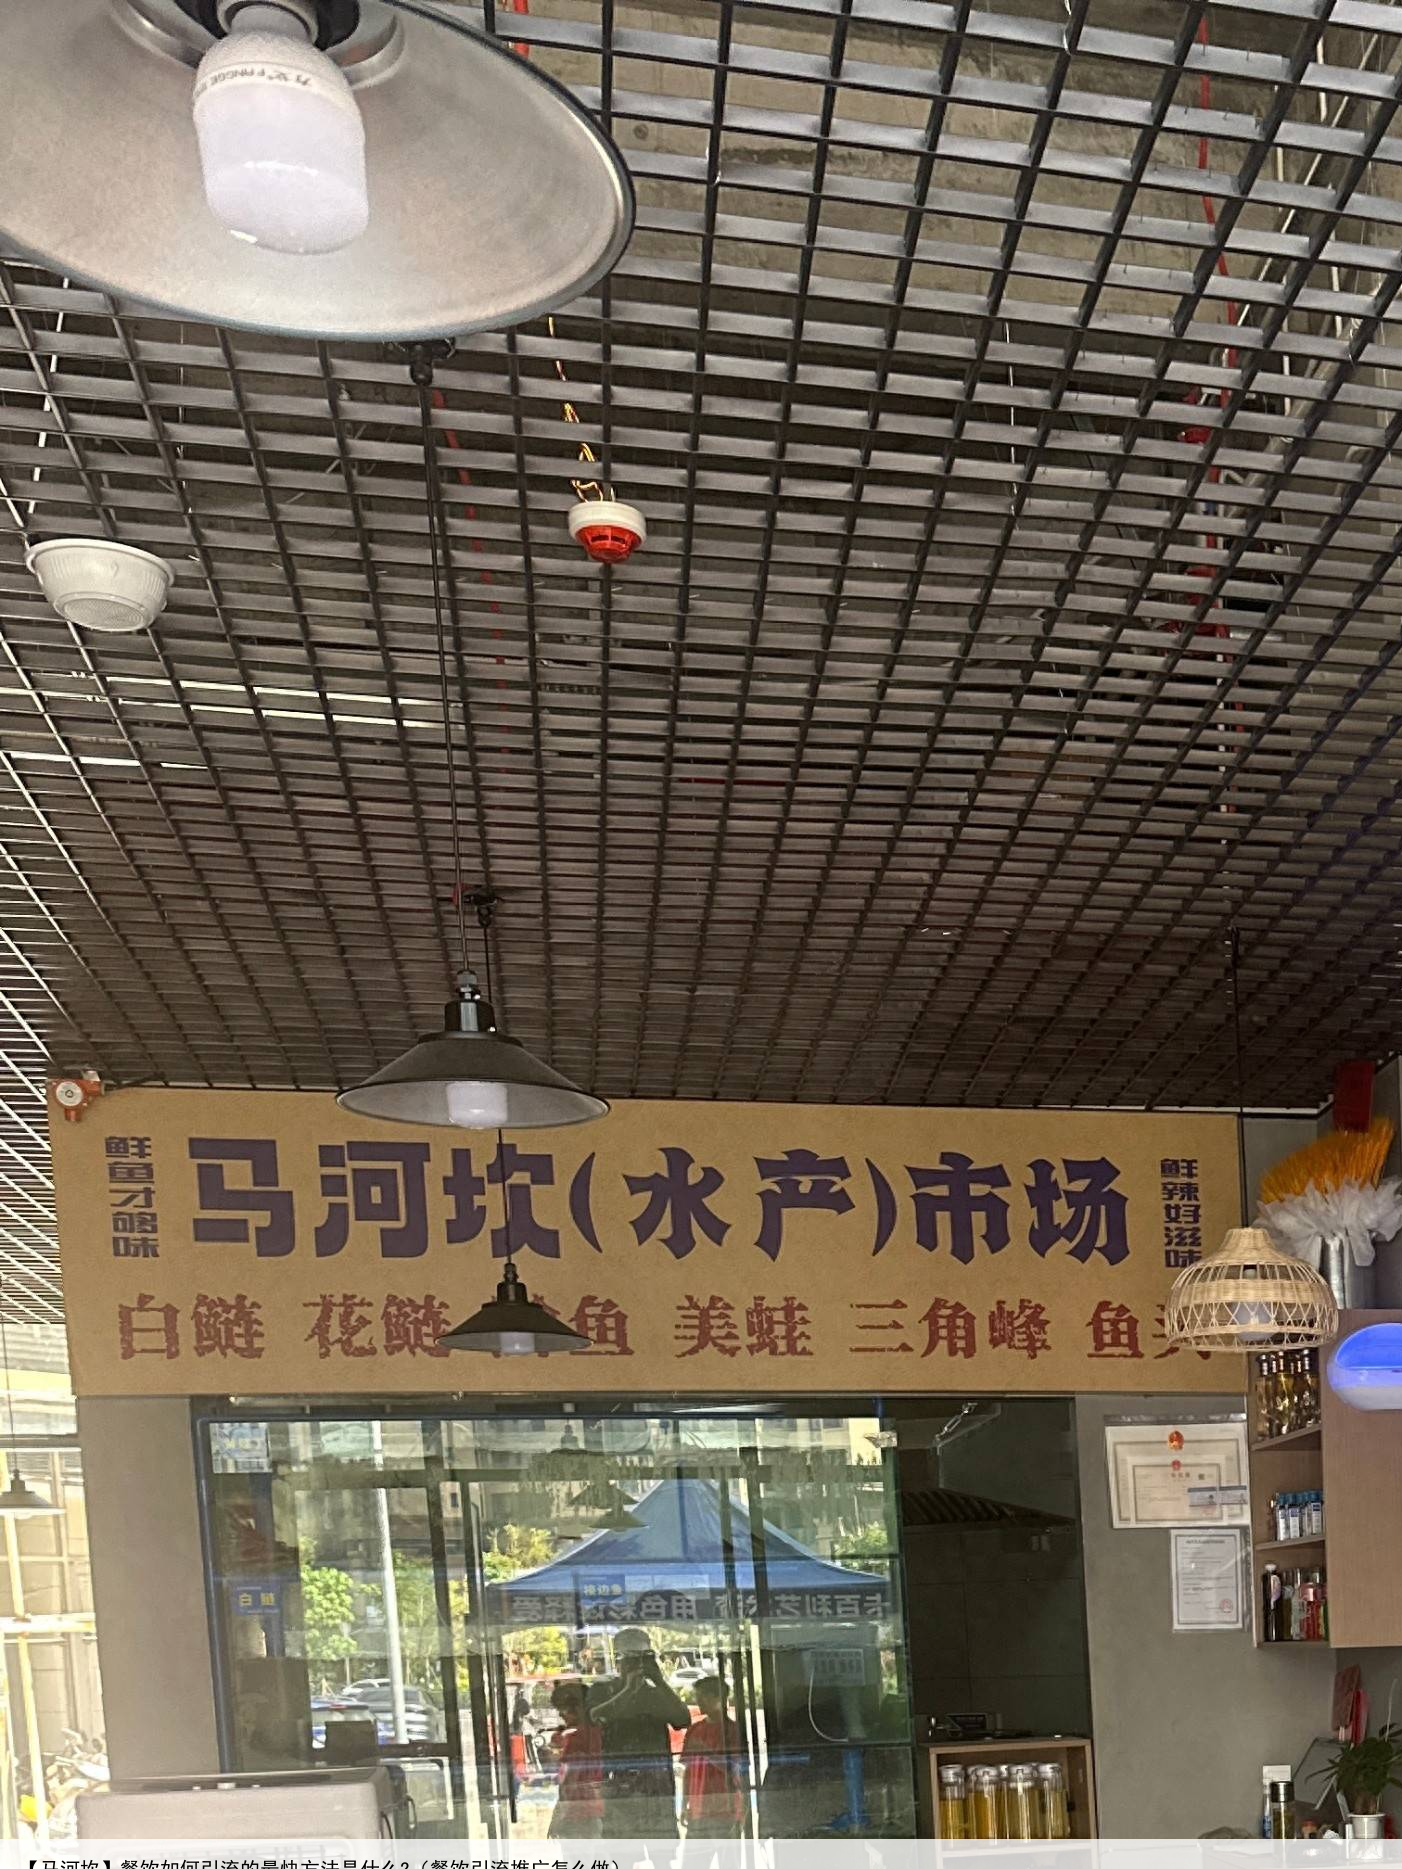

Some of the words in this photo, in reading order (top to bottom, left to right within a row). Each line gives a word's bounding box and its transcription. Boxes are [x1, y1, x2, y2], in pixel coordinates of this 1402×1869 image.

[104, 1135, 160, 1258] 鲜鱼才够味
[188, 1136, 1130, 1266] 马河坎(水产)市场
[1160, 1158, 1202, 1268] 鲜辣好滋味
[118, 1292, 266, 1360] 白鲢
[303, 1293, 451, 1359] 花鲢
[490, 1293, 634, 1358] 鱼
[673, 1294, 814, 1358] 美蛙
[849, 1297, 1052, 1360] 三角峰
